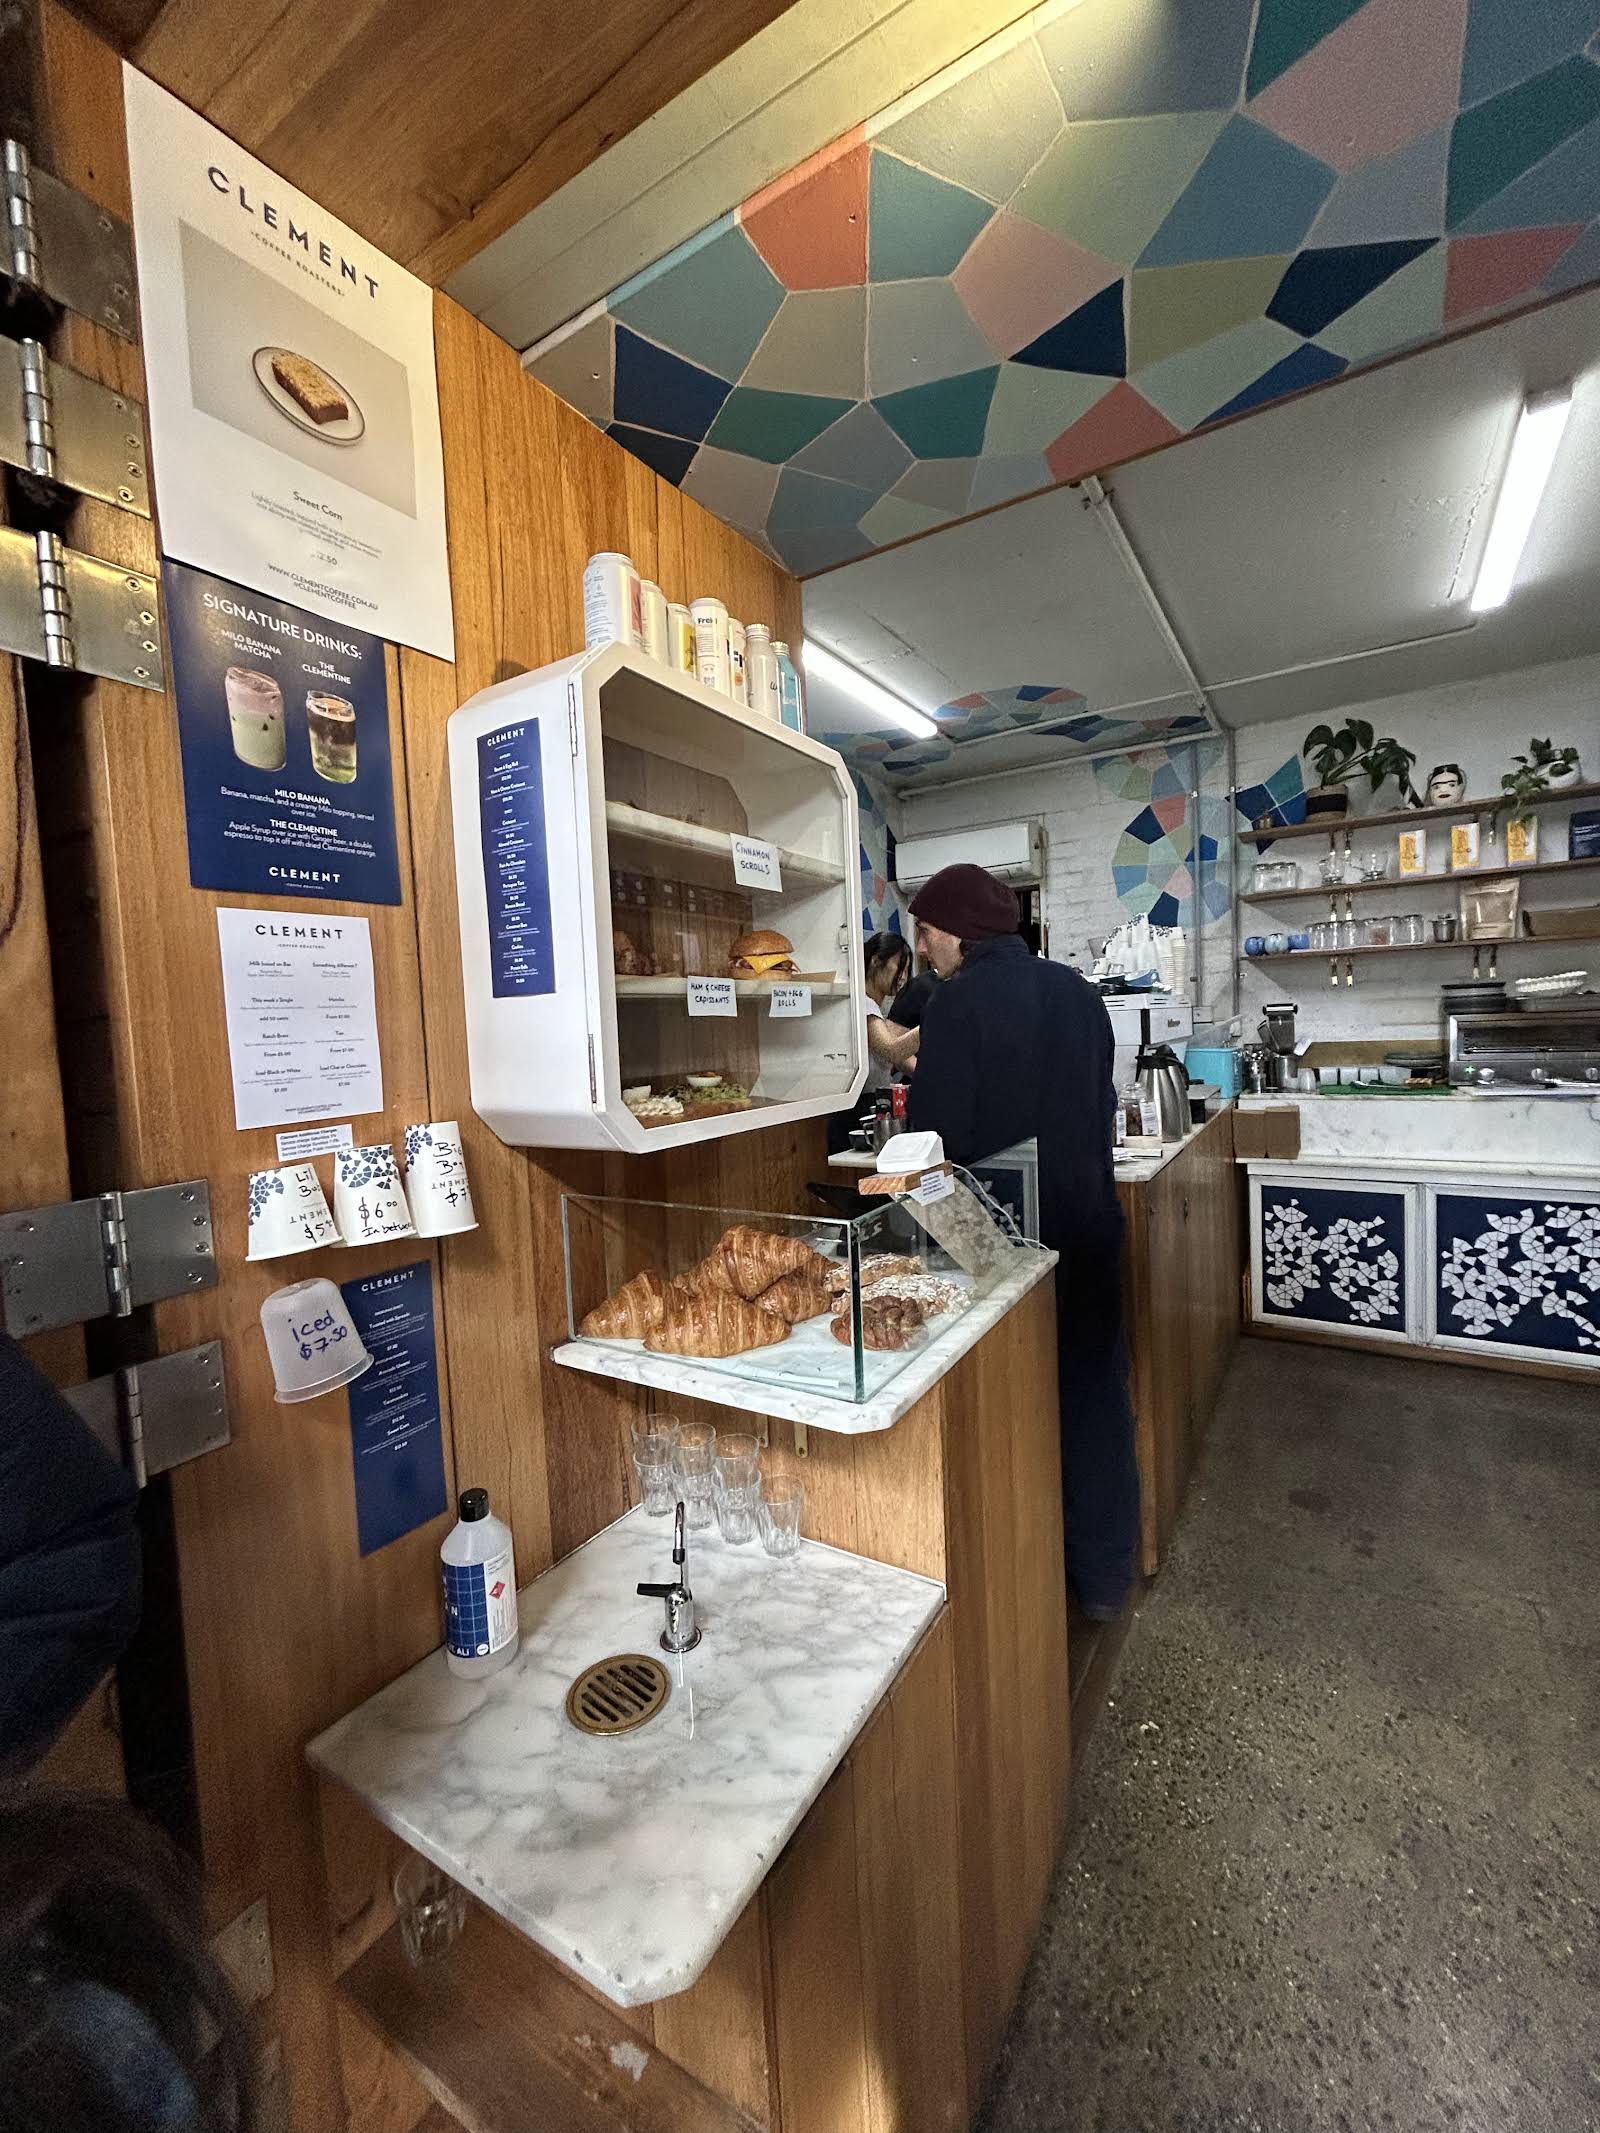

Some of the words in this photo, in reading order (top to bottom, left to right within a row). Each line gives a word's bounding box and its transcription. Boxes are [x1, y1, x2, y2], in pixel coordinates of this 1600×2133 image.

[207, 166, 379, 299] CLEMENT
[292, 490, 320, 510] Sweet
[321, 503, 343, 521] Corn
[203, 592, 301, 640] SIGNATURE
[303, 628, 363, 661] DRINKS:
[221, 628, 244, 643] MILO
[246, 636, 282, 656] BANANA
[235, 641, 272, 661] MATCHA
[302, 663, 351, 685] CLEMENTINE
[319, 660, 335, 673] THE
[487, 728, 525, 747] CLEMENT
[221, 786, 249, 799] Banana,
[275, 789, 297, 800] MILO
[297, 792, 331, 806] BANANA
[291, 809, 305, 817] over
[228, 821, 251, 832] Apple
[251, 824, 271, 836] Syrup
[271, 829, 286, 837] over
[297, 833, 310, 841] with
[311, 833, 333, 845] Ginger
[270, 818, 287, 829] THE
[287, 822, 339, 838] CLEMENTINE
[223, 830, 254, 839] espresso
[263, 836, 275, 844] top
[291, 840, 305, 848] with
[305, 841, 321, 850] dried
[322, 842, 356, 855] Clementine
[735, 842, 770, 861] CINNAMON
[268, 866, 341, 884] CLEMENT
[740, 860, 770, 875] SCROLLS
[255, 924, 344, 940] CLEMENT
[710, 984, 731, 992] CHEESE
[296, 1168, 314, 1182] Lil
[361, 1226, 381, 1237] In
[361, 1270, 415, 1292] CLEMENT
[287, 1309, 335, 1342] iced
[300, 1325, 348, 1360] $7.50
